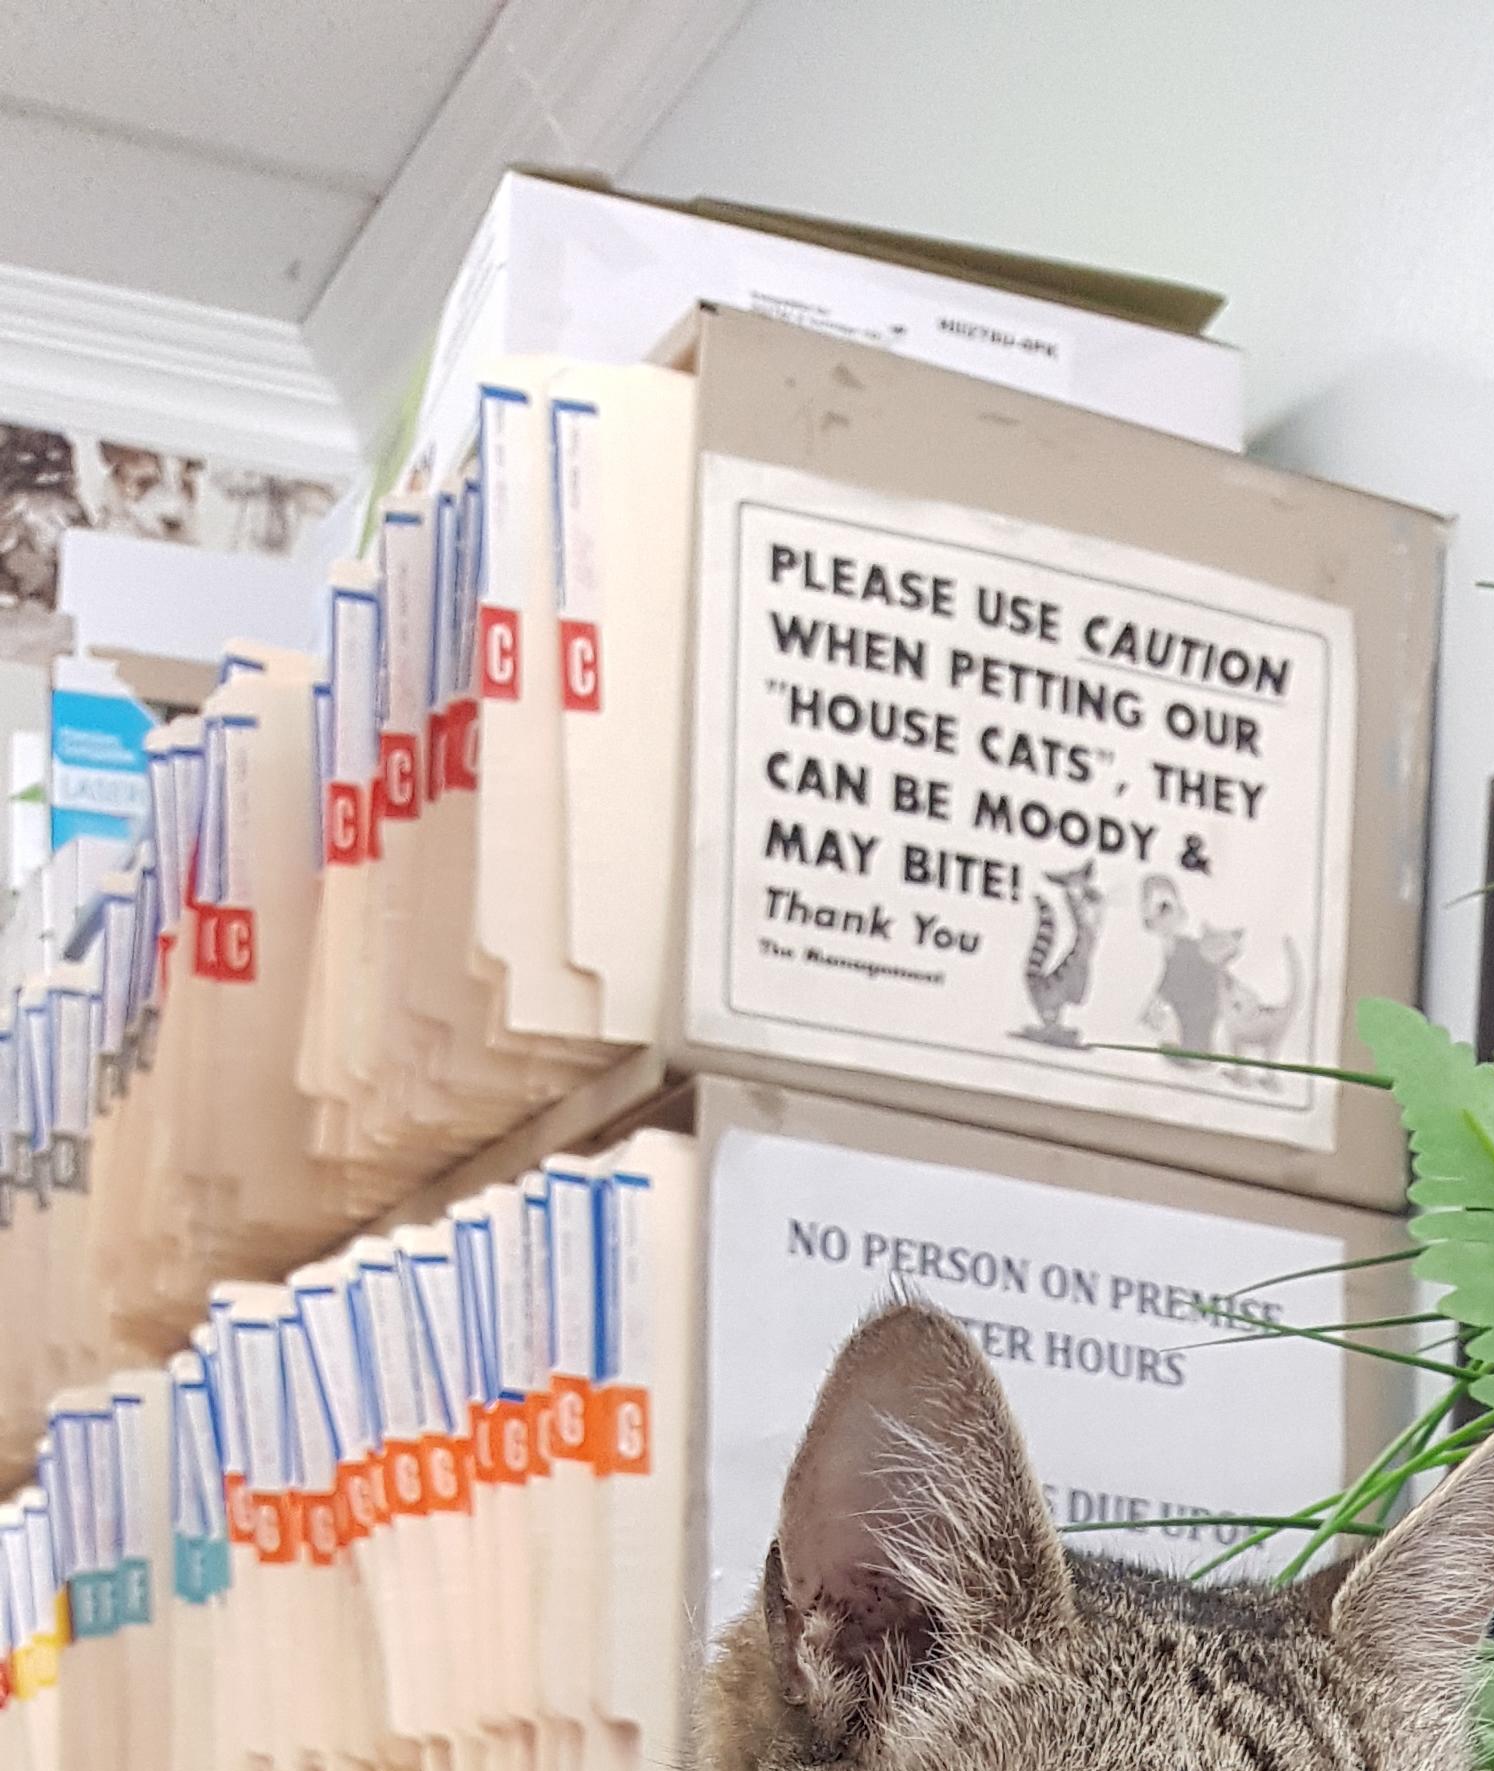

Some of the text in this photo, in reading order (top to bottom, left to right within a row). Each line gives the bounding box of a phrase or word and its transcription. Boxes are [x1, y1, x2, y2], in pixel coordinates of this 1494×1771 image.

[486, 621, 514, 685] C
[769, 542, 1291, 697] PLEASE USE CAUTION
[567, 635, 596, 697] C
[768, 611, 1260, 758] WHEN PETTING OUR
[386, 748, 414, 806] C
[765, 678, 957, 756] "HOUSE
[1151, 760, 1266, 821] THEY
[764, 750, 1211, 876] CAN BE MOODY &
[763, 818, 1022, 902] MAY BITE!
[765, 885, 982, 955] Thank You
[787, 1219, 849, 1263] NO
[862, 1233, 1031, 1294] PERSON
[1040, 1262, 1101, 1307] ON
[1045, 1330, 1186, 1387] HOURS
[617, 1402, 643, 1459] G
[1069, 1486, 1149, 1534] DUE
